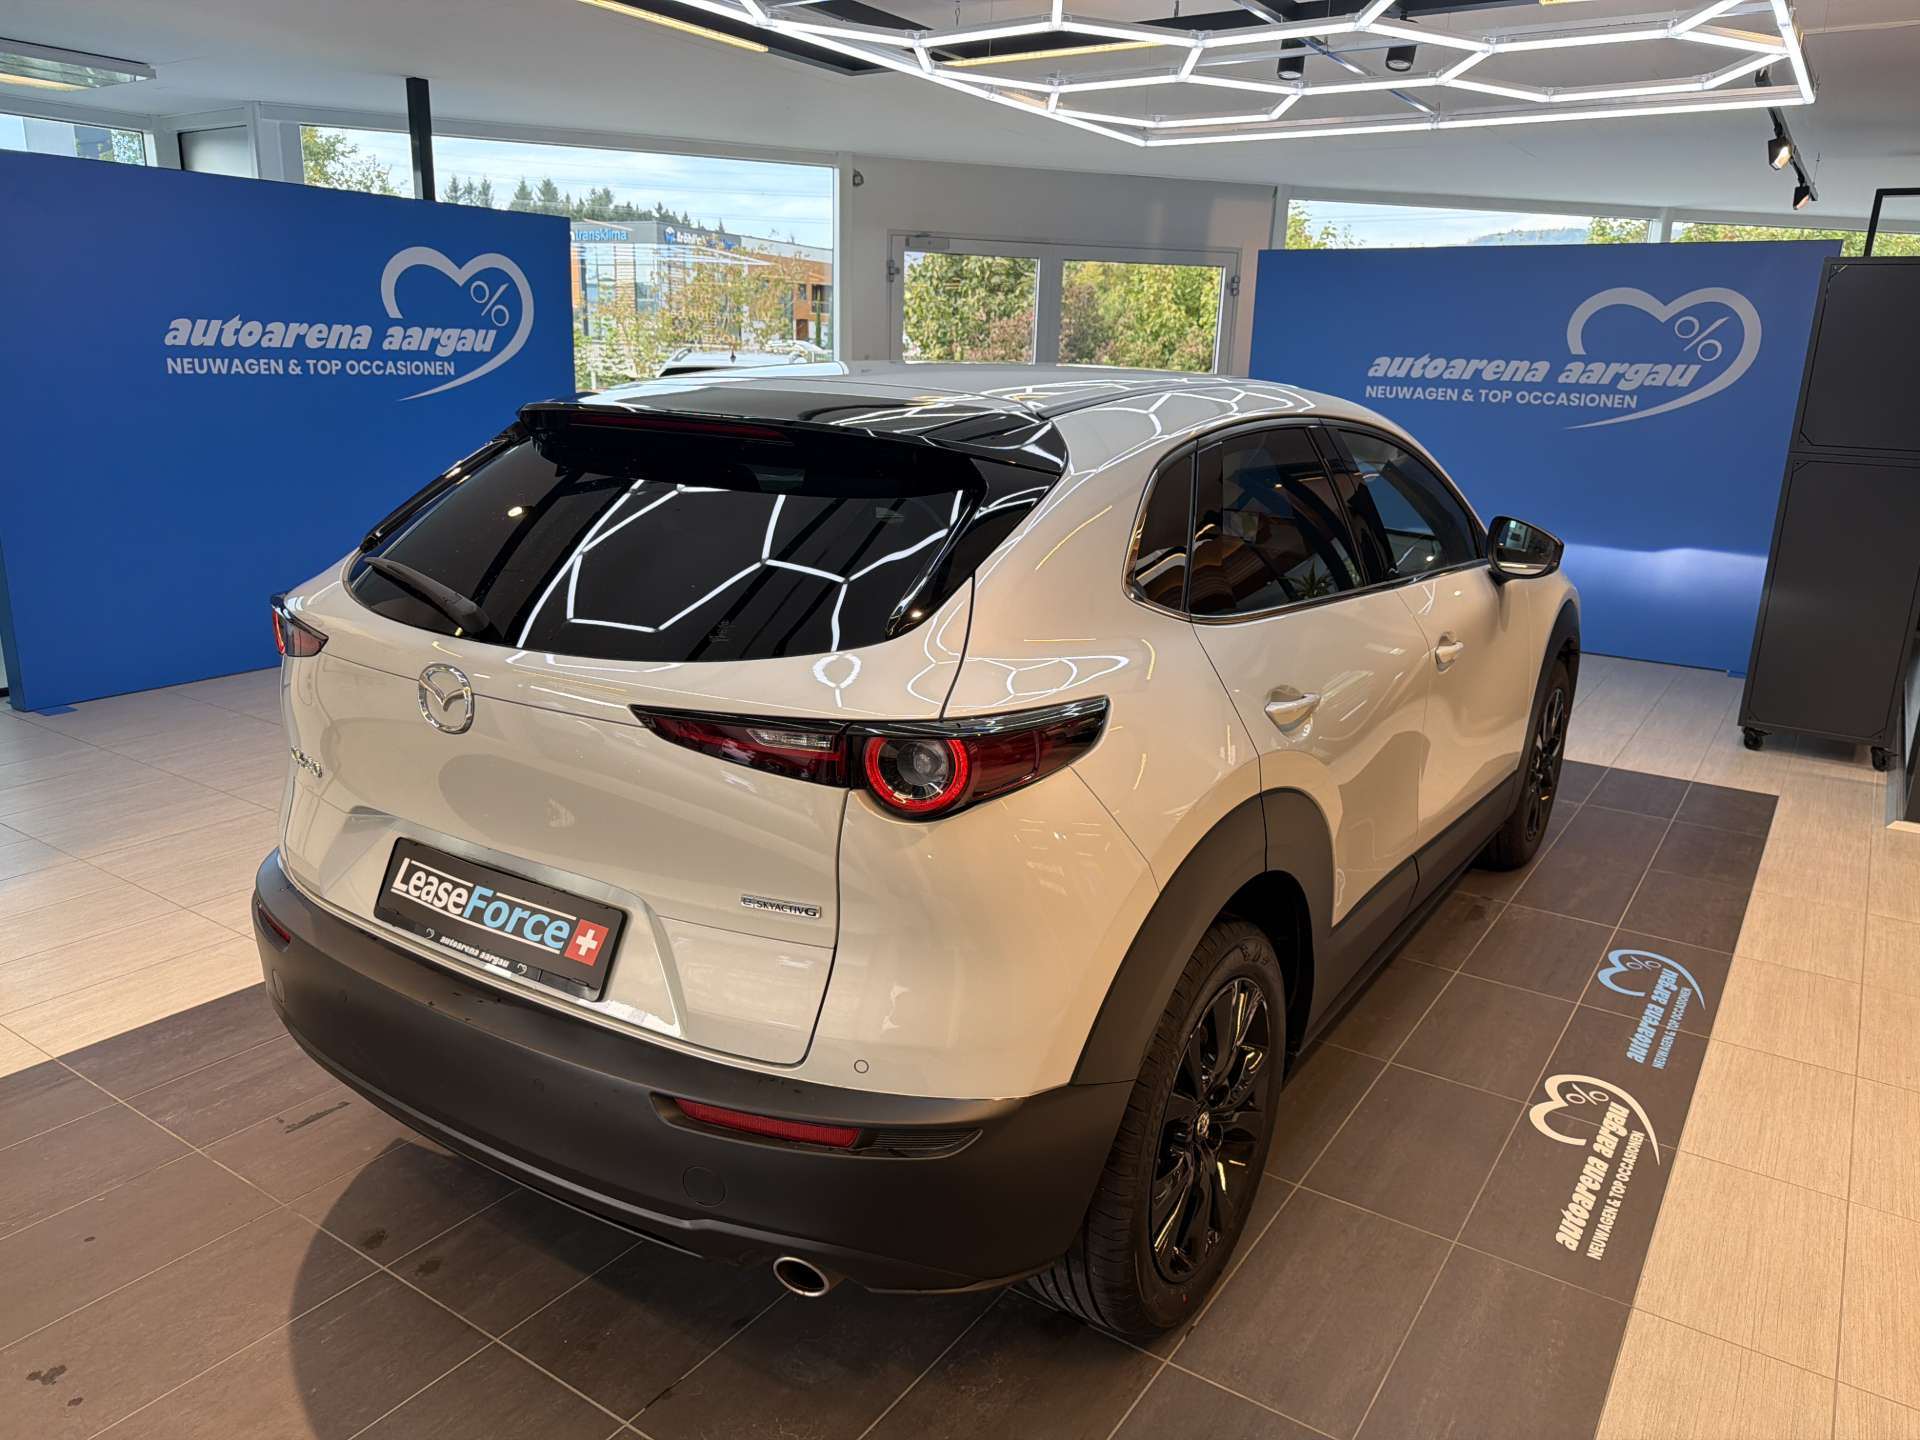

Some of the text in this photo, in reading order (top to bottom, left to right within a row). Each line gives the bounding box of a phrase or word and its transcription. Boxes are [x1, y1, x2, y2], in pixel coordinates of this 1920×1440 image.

[164, 314, 497, 357] autoarena aargau
[166, 357, 455, 376] NEUWAGEN & TOP OCCASIONEN
[1367, 353, 1702, 391] autoarena aargau
[1365, 385, 1638, 409] NEUWAGEN & TOP OCCASIONEN
[392, 858, 571, 949] LeaseForce
[440, 934, 510, 968] autoarena aargau
[1625, 967, 1679, 1064] autoarena aargau
[1651, 1036, 1675, 1069] NEUWAGEN
[1555, 1101, 1630, 1251] autoarena aargau
[1586, 1130, 1645, 1261] NEUWAGEN & TOP OCCASIONEN
